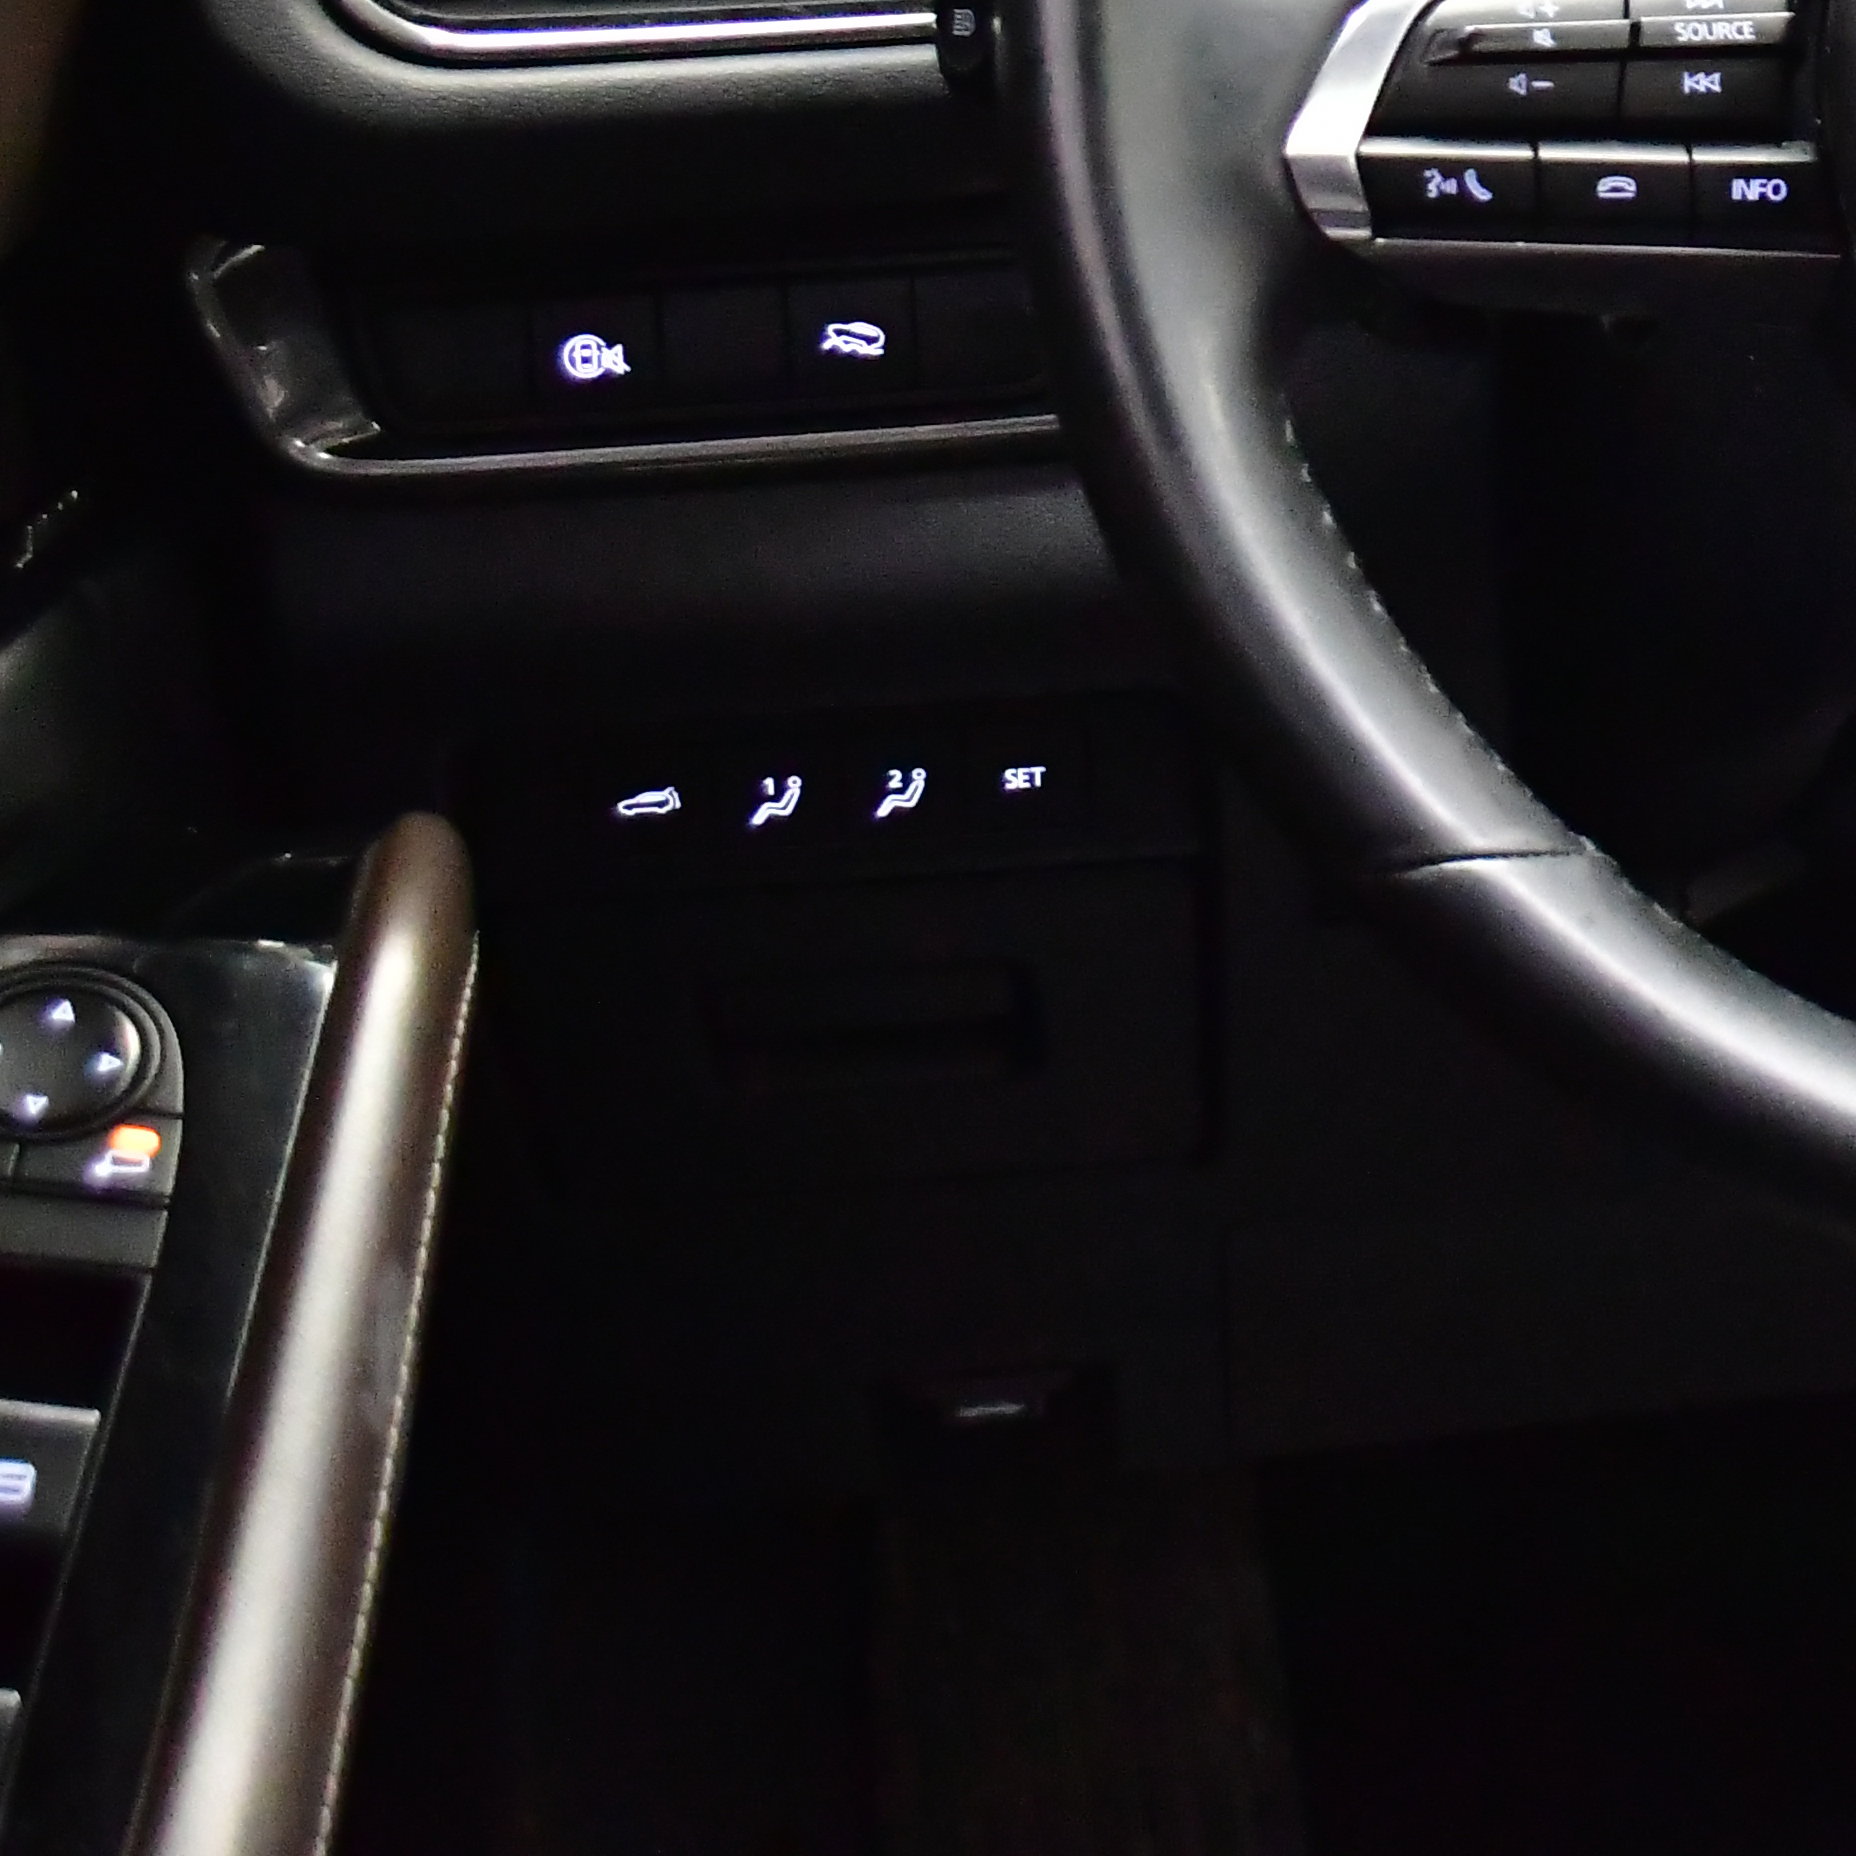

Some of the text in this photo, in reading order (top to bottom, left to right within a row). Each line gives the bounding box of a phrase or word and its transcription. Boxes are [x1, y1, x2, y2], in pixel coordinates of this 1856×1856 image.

[1675, 20, 1756, 42] SOURCE
[1731, 178, 1788, 202] INFO
[1003, 767, 1046, 790] SET
